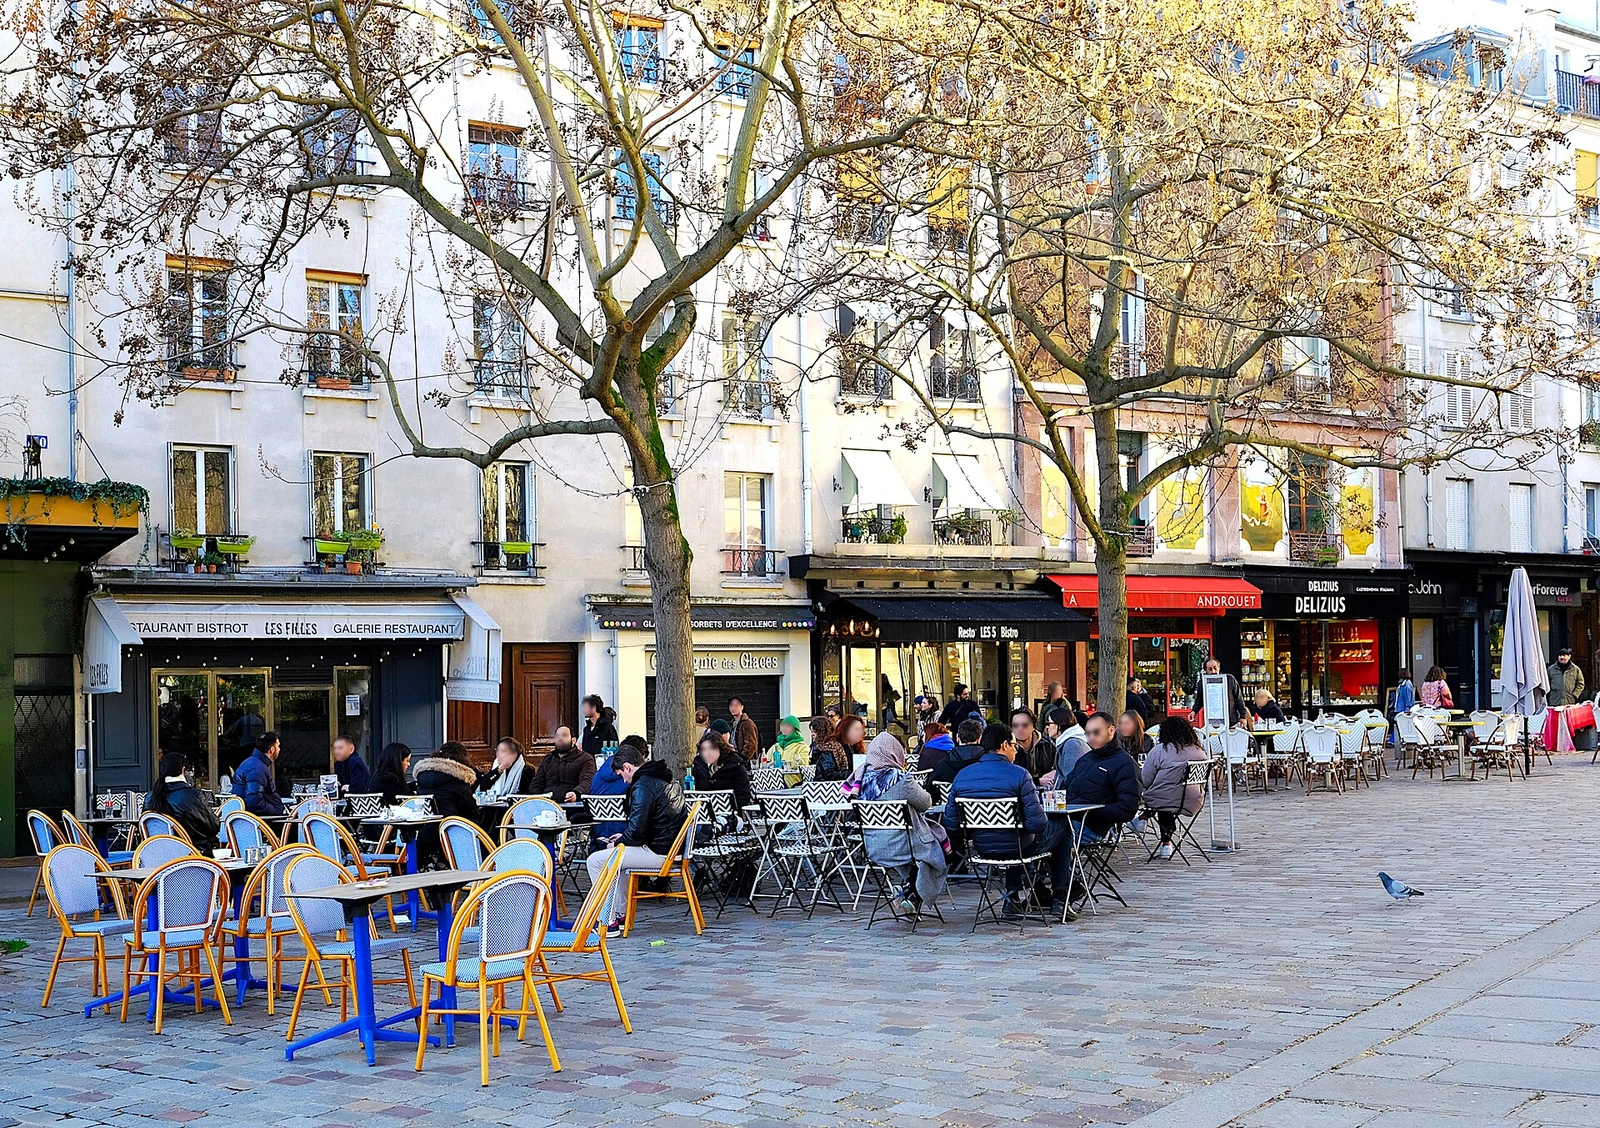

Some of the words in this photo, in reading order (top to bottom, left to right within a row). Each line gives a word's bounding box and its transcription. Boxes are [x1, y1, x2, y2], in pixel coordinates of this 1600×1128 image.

[1308, 581, 1339, 592] DELIZIUS
[1069, 594, 1077, 606] A
[1197, 595, 1256, 607] ANDROUET
[1295, 596, 1346, 613] DELIZIUS
[196, 622, 249, 633] BISTROT
[265, 621, 283, 635] LES
[285, 622, 318, 635] FILLES
[333, 623, 381, 634] GALERIE
[384, 623, 456, 634] RESTAURANT
[725, 620, 778, 628] D'EXCELLENCE
[980, 625, 991, 638] LES
[991, 625, 997, 638] 5
[1000, 625, 1019, 638] Bistro
[722, 658, 737, 669] des
[739, 652, 778, 669] Glaces
